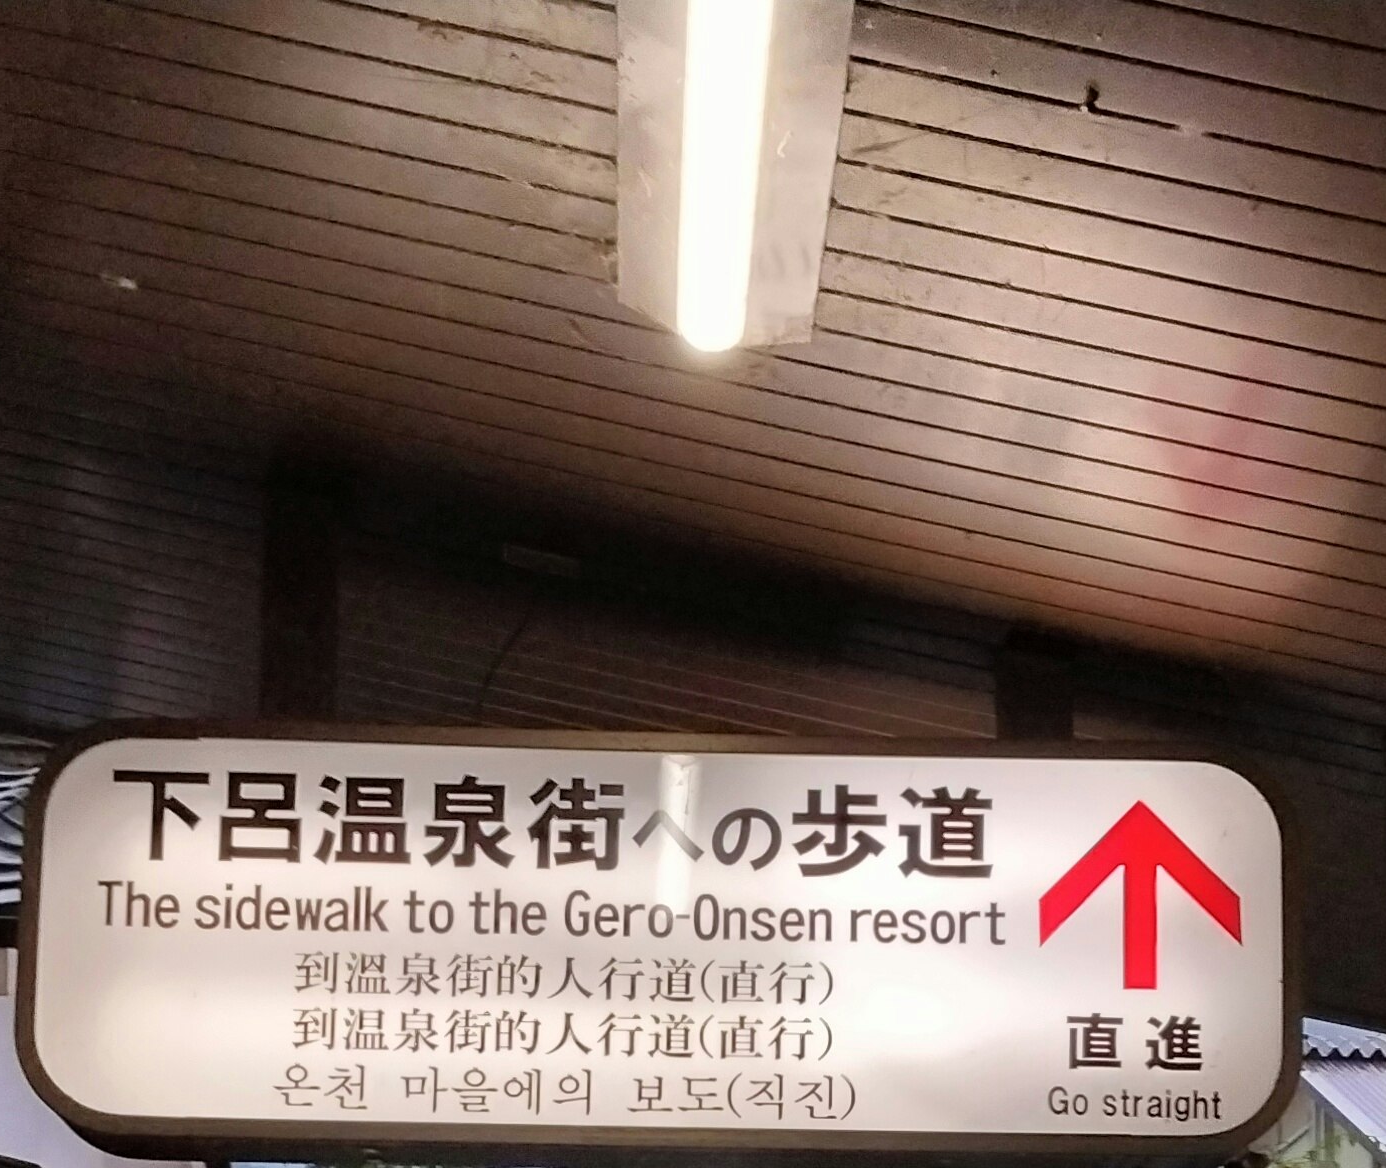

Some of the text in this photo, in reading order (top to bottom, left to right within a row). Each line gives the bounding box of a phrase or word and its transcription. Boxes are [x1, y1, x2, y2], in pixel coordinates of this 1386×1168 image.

[112, 769, 993, 879] 下呂温泉街への歩道
[97, 879, 1007, 946] The sidewalk to the Gero-Onsen resort
[293, 950, 835, 1006] 到溫泉街的人行道(直行)
[291, 1006, 834, 1062] 到温泉街的人行道(直行)
[1066, 1012, 1204, 1071] 直進
[272, 1062, 857, 1121] 온천 마을에의 보도(직진)
[1047, 1086, 1223, 1122] Go straight
